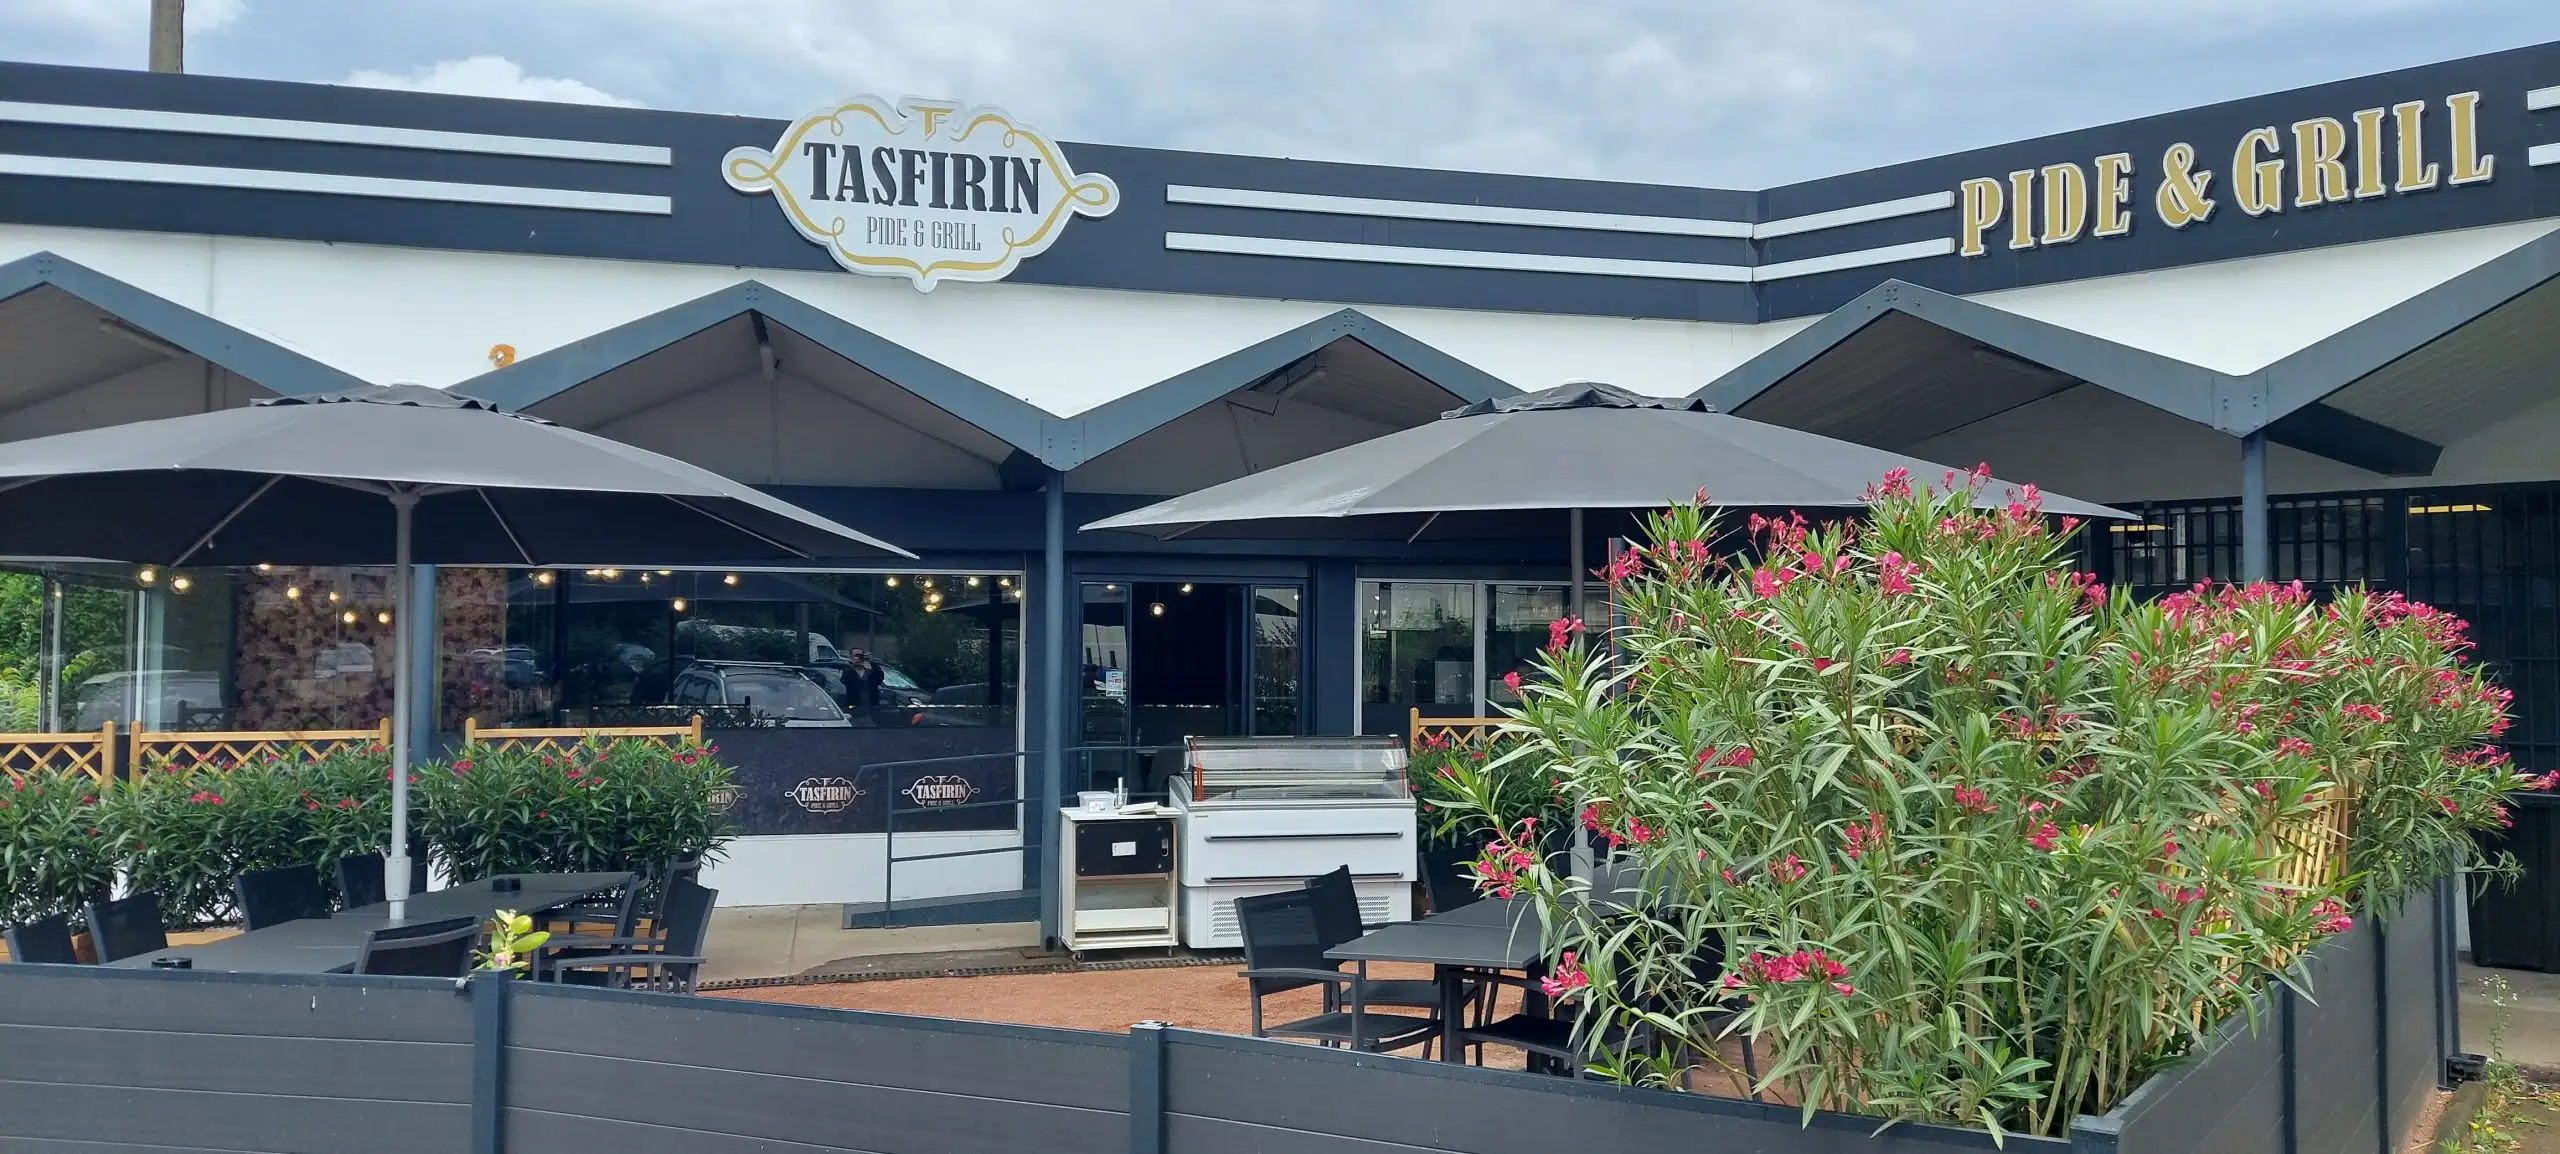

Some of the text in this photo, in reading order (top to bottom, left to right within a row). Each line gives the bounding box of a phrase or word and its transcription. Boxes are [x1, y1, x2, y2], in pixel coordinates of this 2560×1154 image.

[803, 142, 1041, 215] TASFIRIN
[1960, 91, 2494, 257] PIDE & GRILL
[866, 216, 981, 251] PIDE & GRILL
[800, 786, 851, 801] TASFIRIN
[916, 784, 966, 799] TASFIRIN
